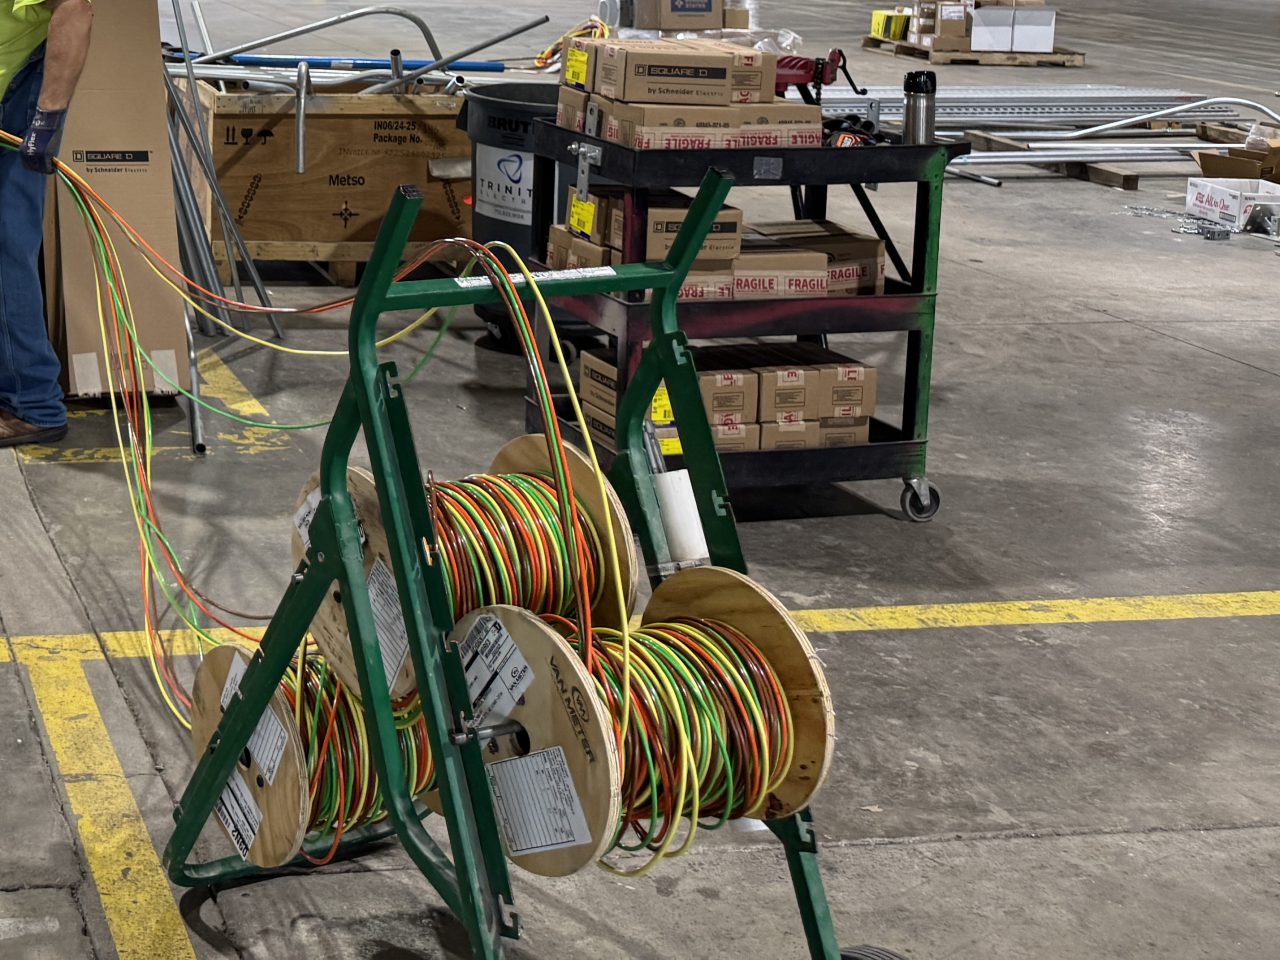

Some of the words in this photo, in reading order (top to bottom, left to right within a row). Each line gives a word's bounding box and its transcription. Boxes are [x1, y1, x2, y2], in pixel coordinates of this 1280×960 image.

[650, 67, 695, 76] SQUARE
[647, 87, 657, 95] by
[658, 87, 693, 96] Schneider
[374, 121, 417, 130] IN06/24-25
[374, 133, 408, 145] Package
[409, 133, 423, 143] No.
[665, 138, 711, 149] FRAGILE
[739, 135, 778, 148] FRAGIL
[791, 134, 822, 145] AGILE
[328, 174, 365, 186] Metso
[480, 178, 533, 198] TRINIT
[733, 279, 775, 290] RAGILE
[549, 655, 567, 695] VAN
